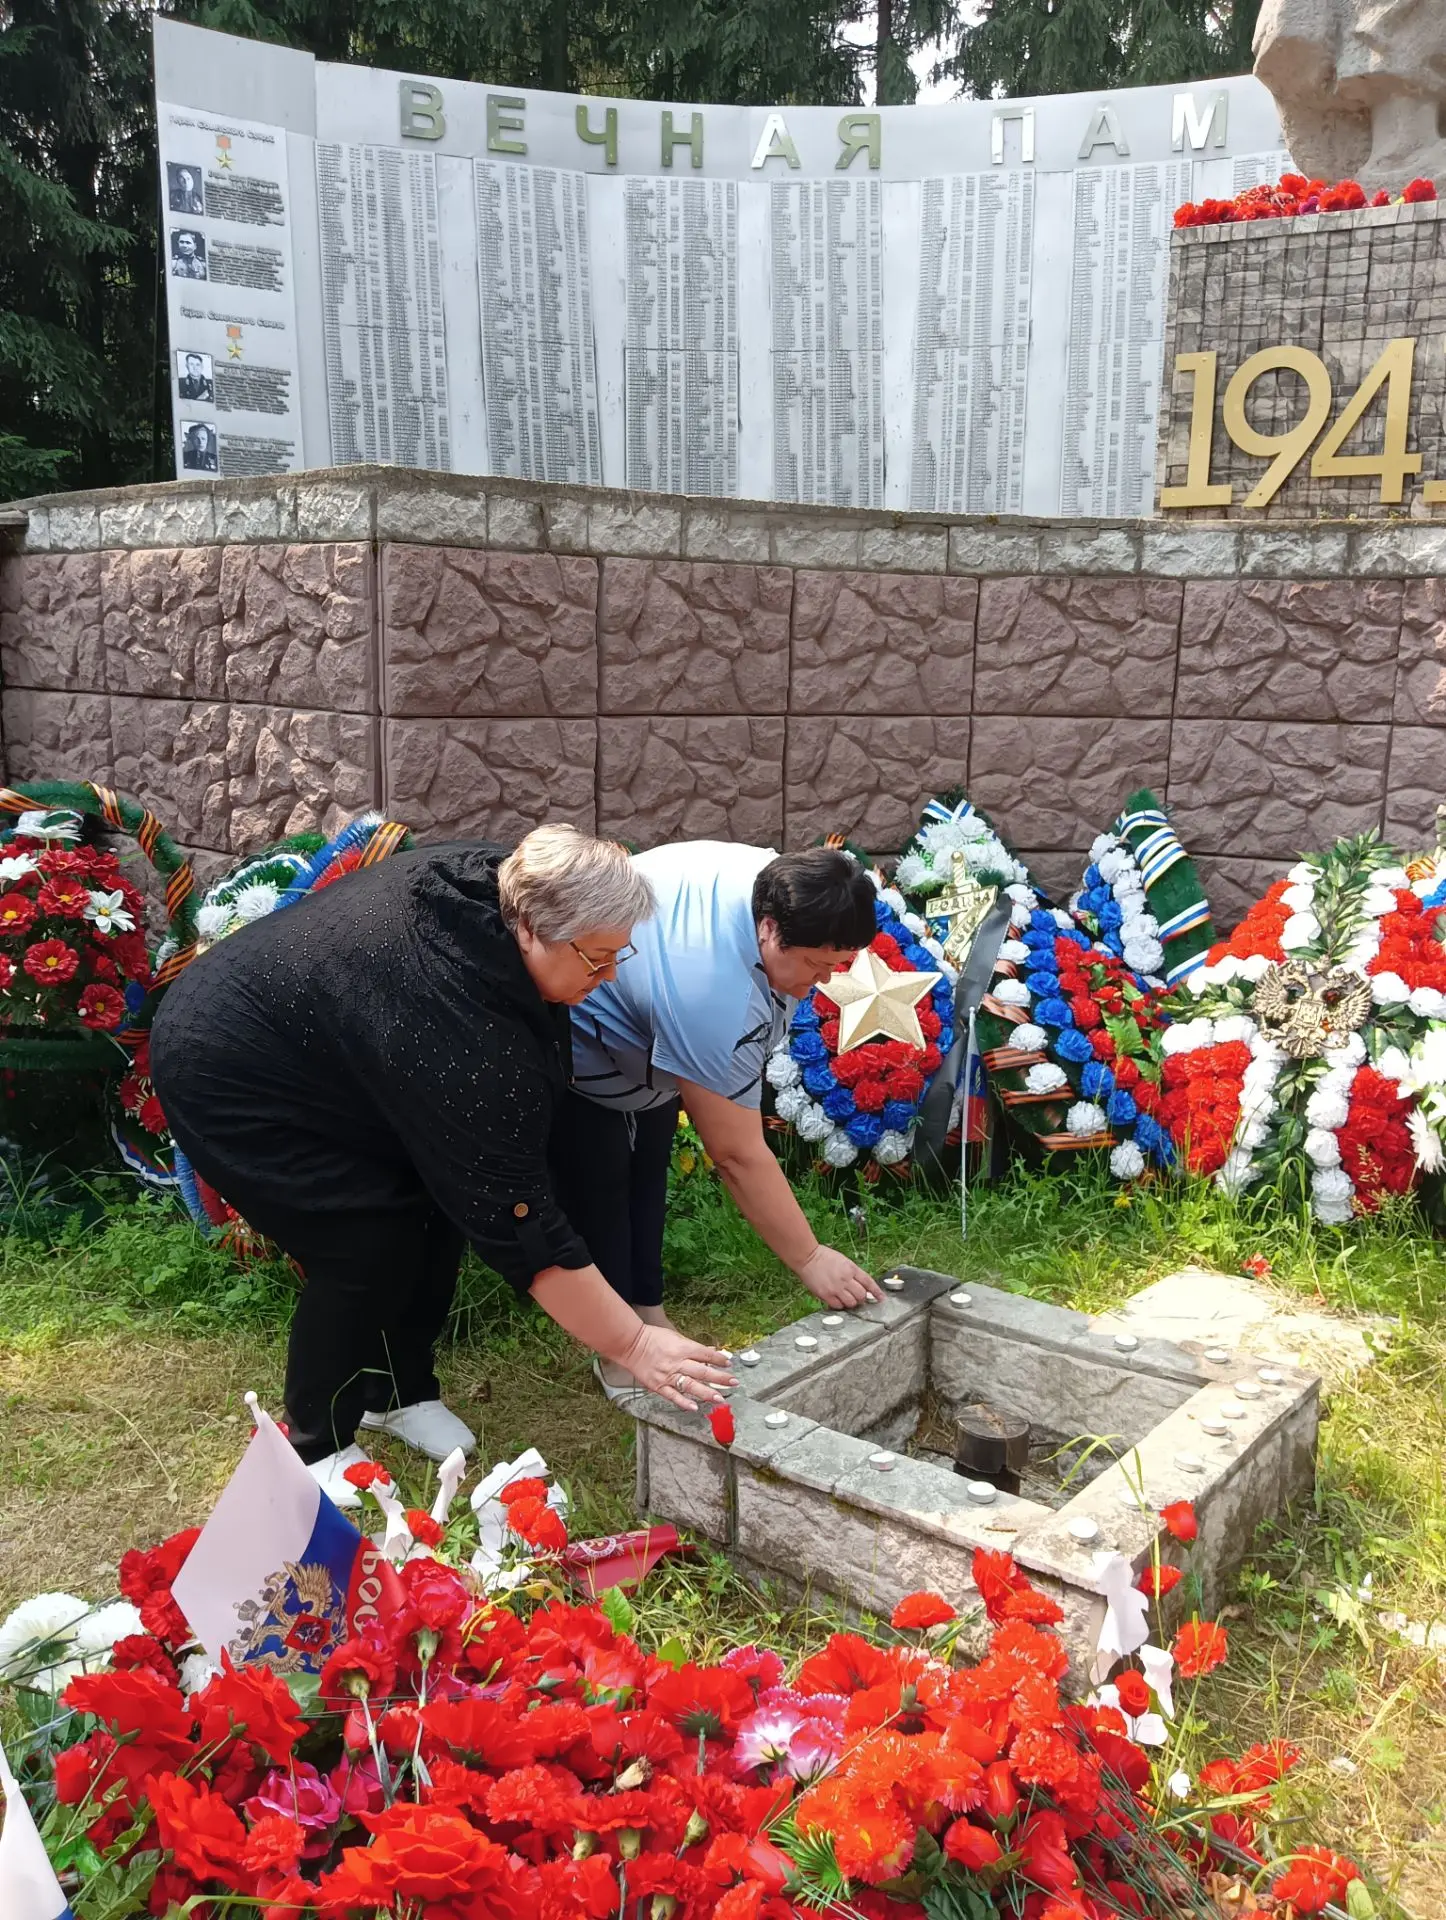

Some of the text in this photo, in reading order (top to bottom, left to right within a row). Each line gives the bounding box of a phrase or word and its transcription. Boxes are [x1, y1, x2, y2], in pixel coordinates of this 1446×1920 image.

[400, 79, 1285, 170] ВЕЧНАЯ ПАМ
[1159, 337, 1446, 508] 194
